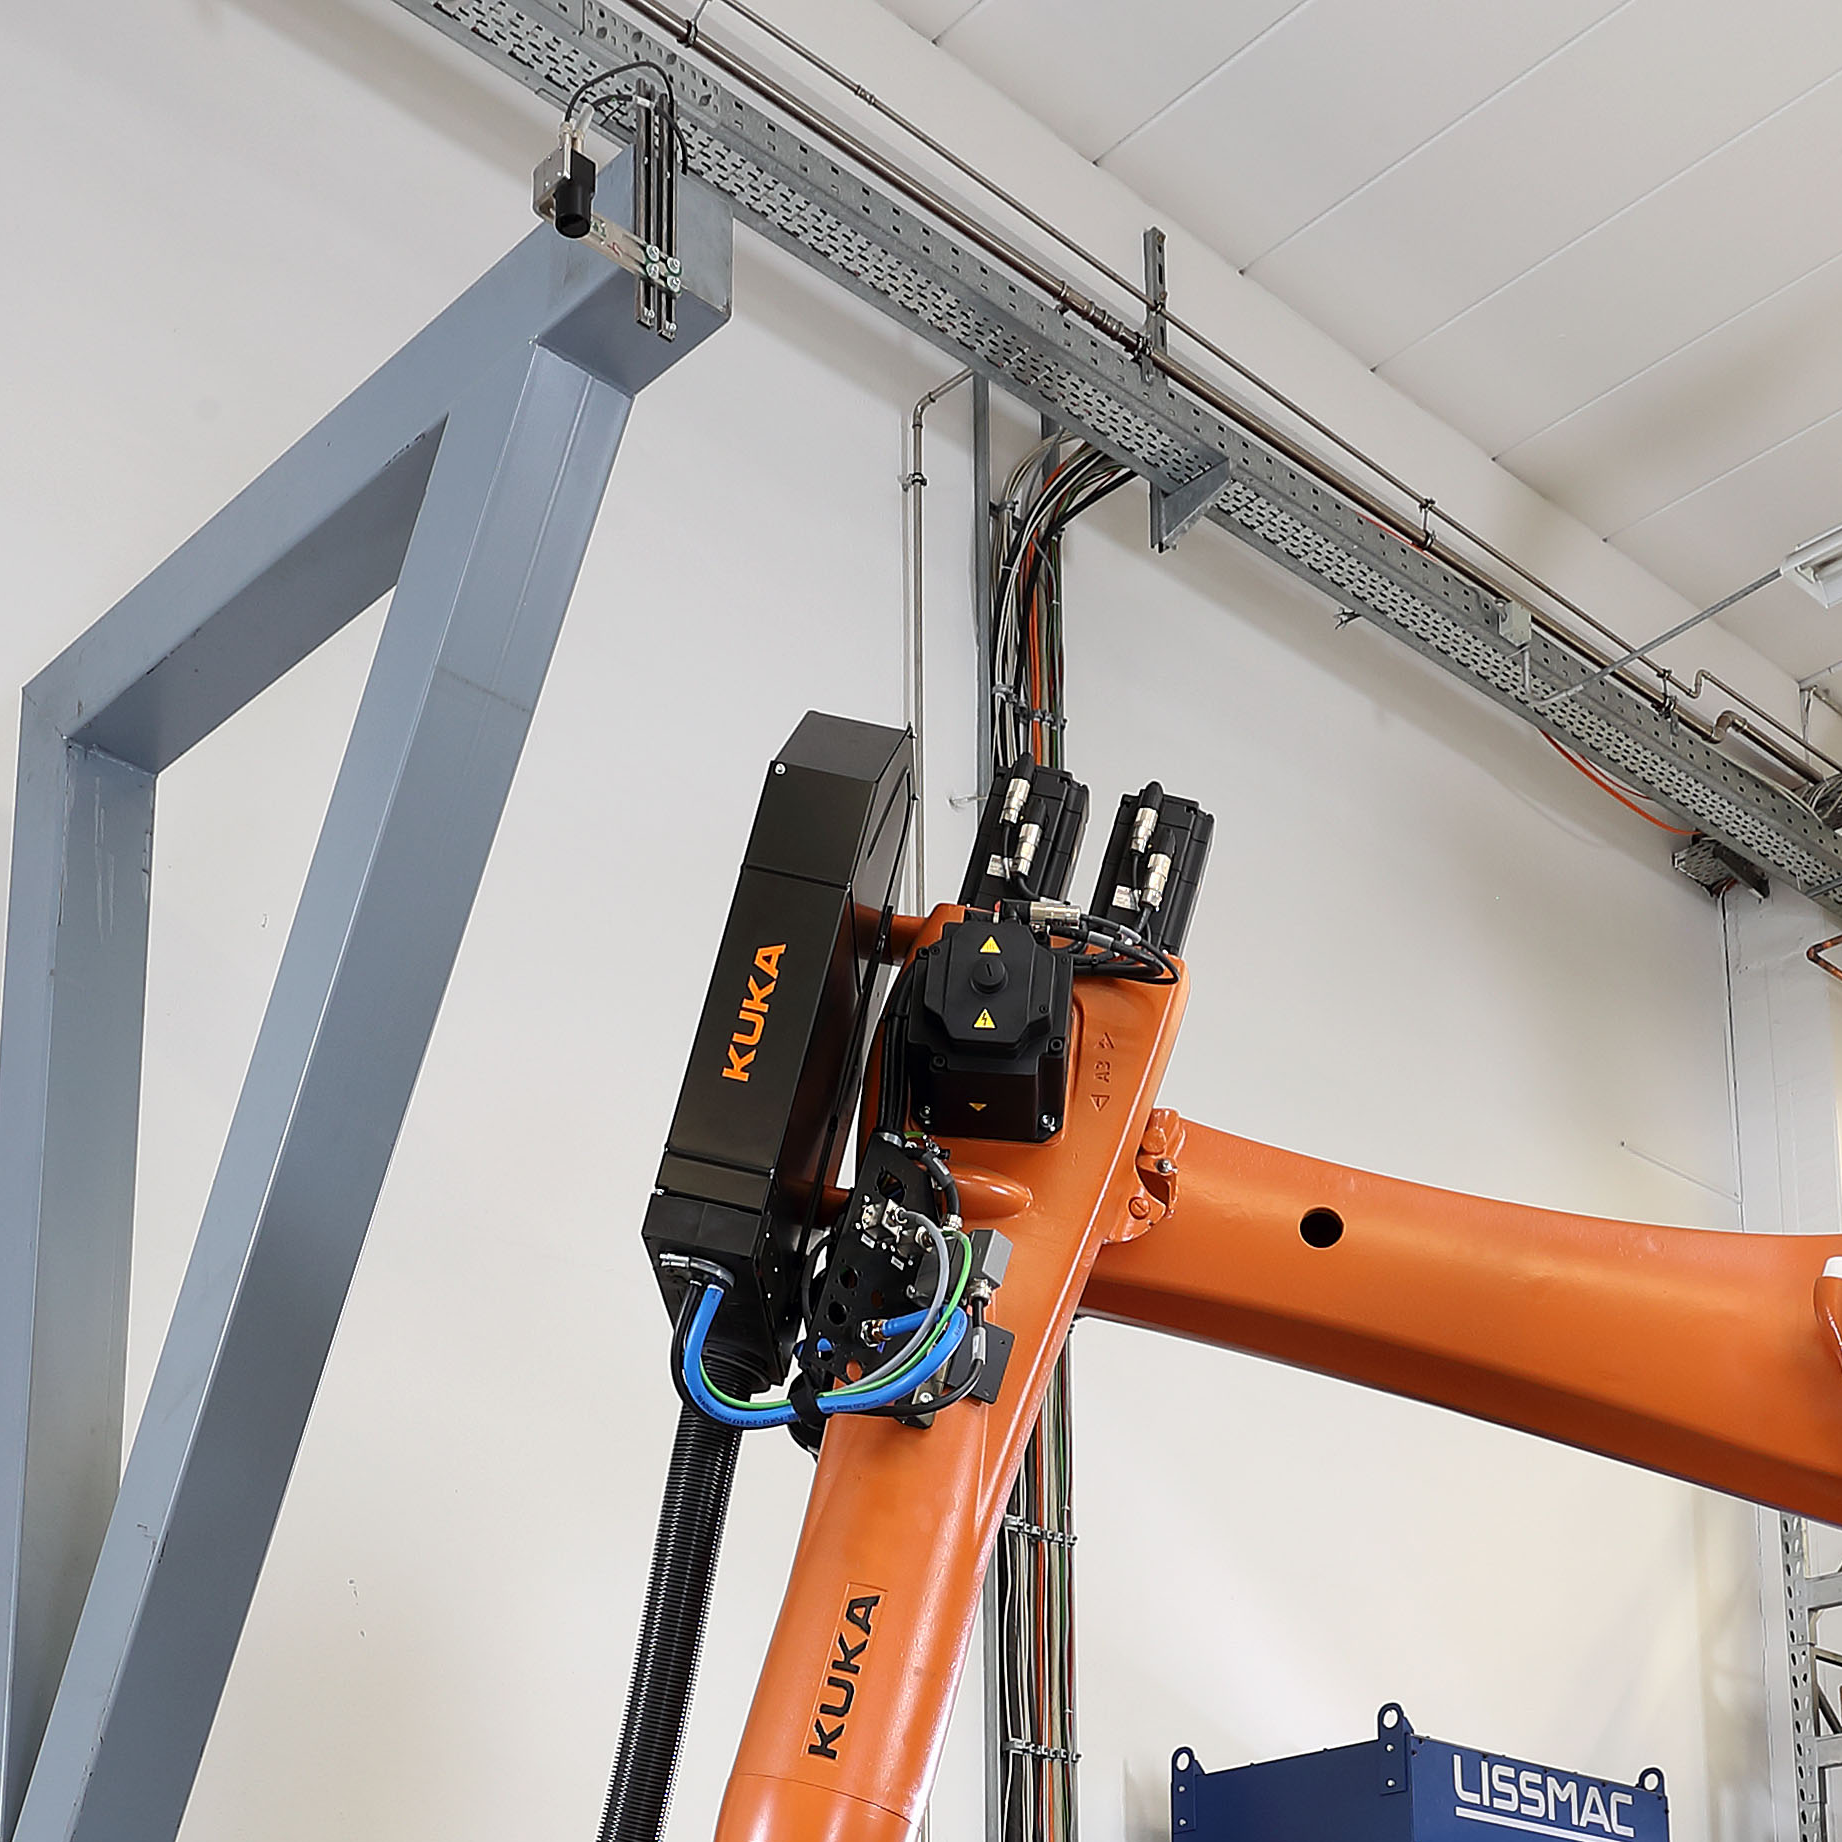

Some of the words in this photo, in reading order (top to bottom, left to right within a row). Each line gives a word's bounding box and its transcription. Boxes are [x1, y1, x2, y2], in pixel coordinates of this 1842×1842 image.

[722, 943, 787, 1082] KUKA
[807, 1594, 882, 1761] KUKA
[1453, 1753, 1636, 1838] LISSMAC
